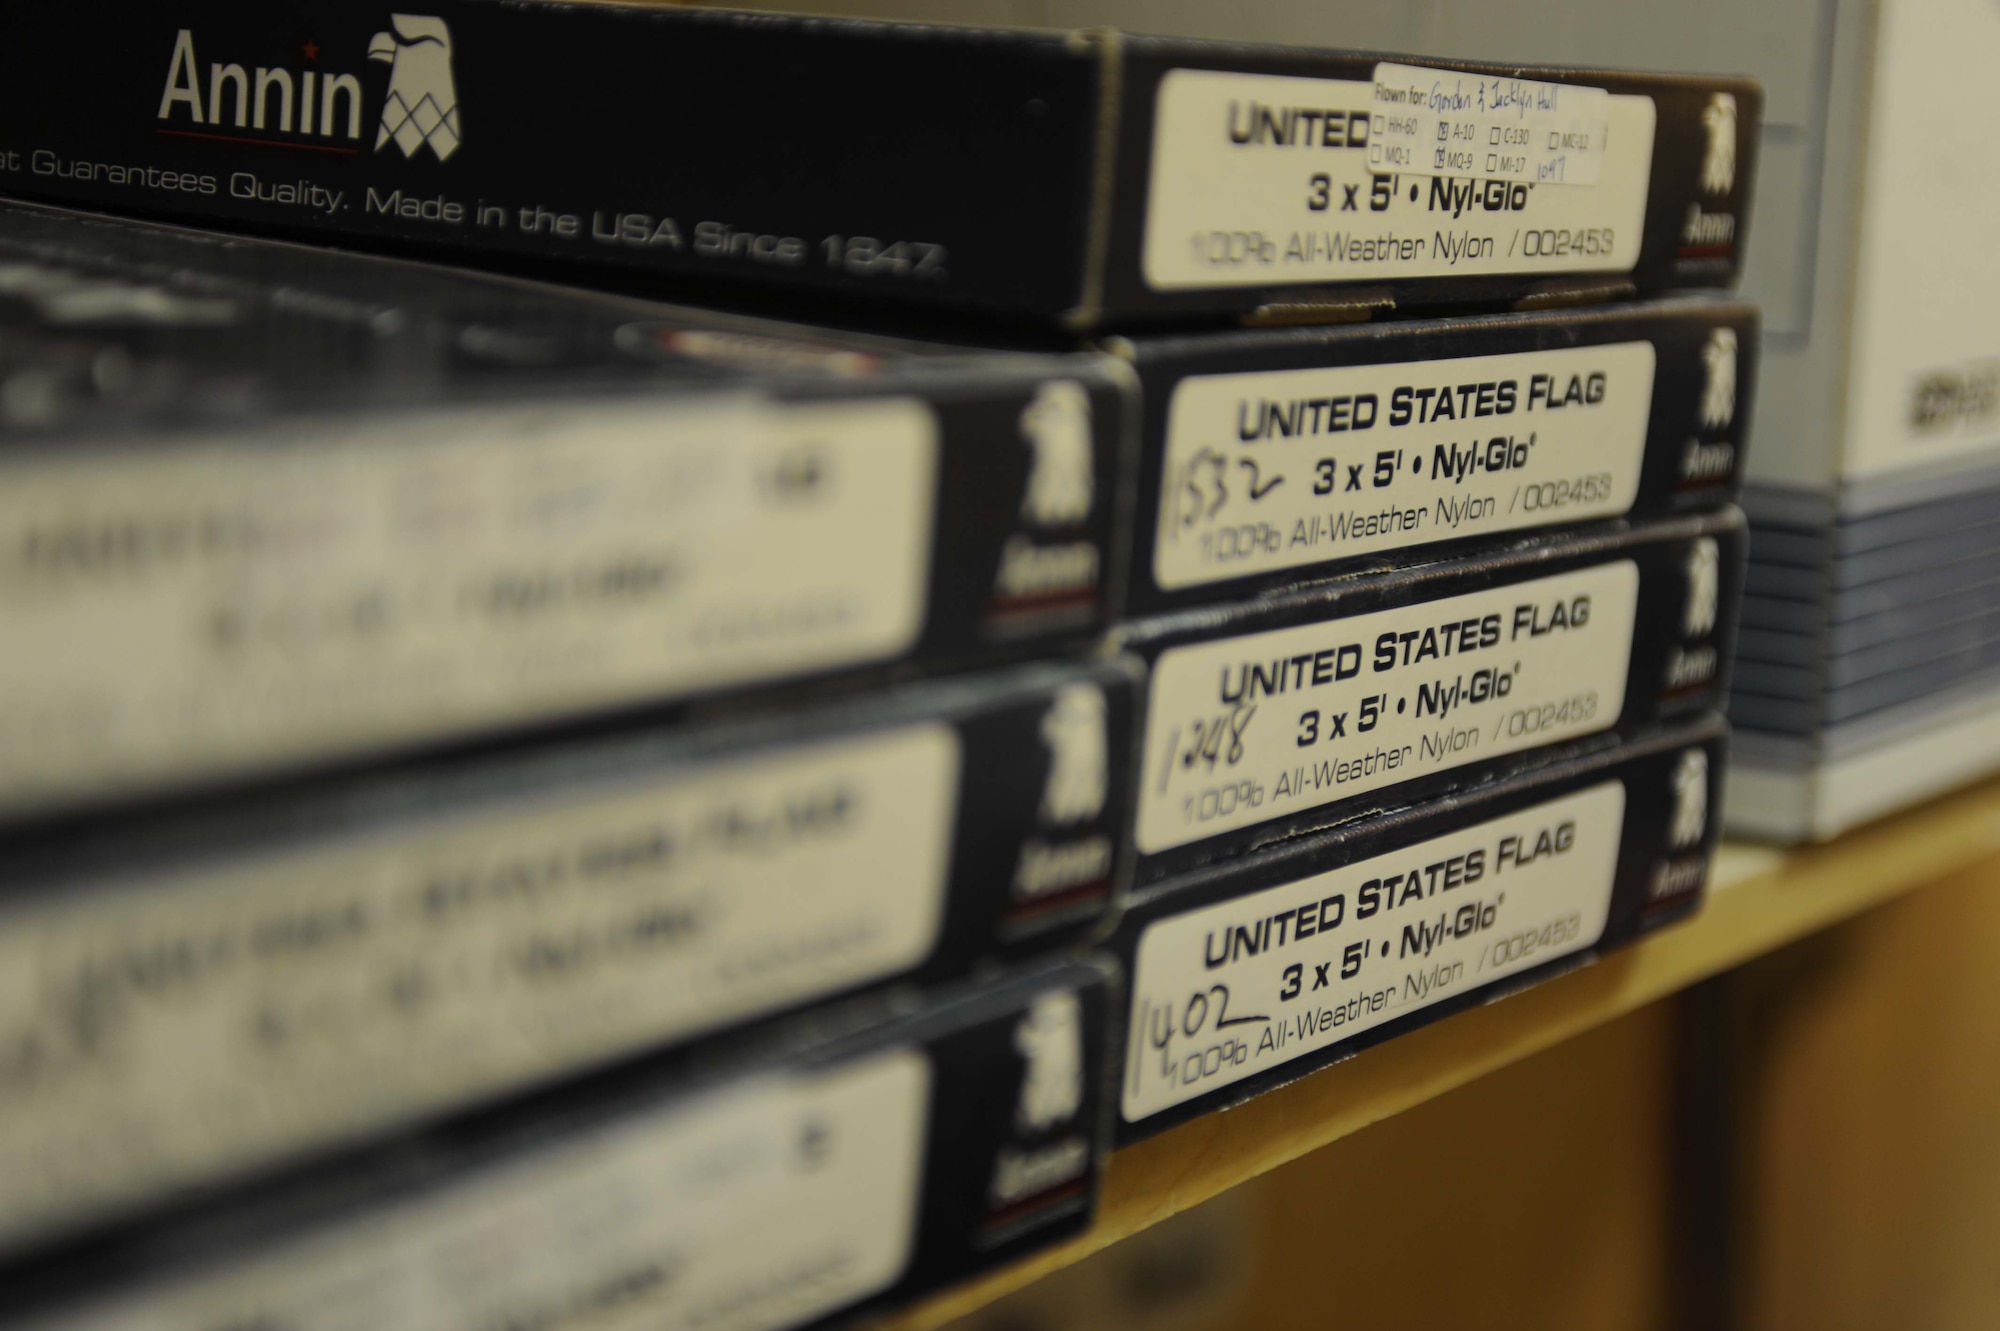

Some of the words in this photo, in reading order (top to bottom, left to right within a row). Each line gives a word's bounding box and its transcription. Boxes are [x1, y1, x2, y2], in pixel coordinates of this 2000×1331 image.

[158, 29, 361, 140] Annin
[1374, 83, 1408, 102] Flown
[1409, 85, 1428, 106] for:
[1428, 79, 1471, 114] Gordon
[1229, 99, 1370, 149] UNITED
[1452, 122, 1476, 142] A-10
[1503, 127, 1530, 146] C-130
[1384, 145, 1411, 166] MQ-1
[1446, 150, 1473, 171] MQ-9
[1499, 154, 1527, 173] MI-17
[31, 149, 217, 195] Guarantees
[229, 172, 349, 215] Quality.
[365, 186, 463, 223] Made
[476, 197, 506, 228] in
[518, 204, 581, 237] the
[591, 209, 684, 251] USA
[693, 219, 806, 268] Since
[1306, 173, 1332, 212] 3
[1340, 184, 1360, 210] x
[1283, 228, 1424, 263] All-Weather
[1432, 228, 1494, 265] Nylon
[1237, 391, 1379, 443] UNITED
[1387, 378, 1518, 428] STATES
[1527, 370, 1607, 411] FLAG
[1312, 458, 1336, 496] 3
[1345, 466, 1363, 492] x
[1289, 503, 1429, 550] All-Weather
[1435, 494, 1495, 532] Nylon
[1219, 641, 1362, 705] UNITED
[1373, 612, 1501, 671] STATES
[1511, 594, 1592, 642] FLAG
[1296, 711, 1319, 748] 3
[1328, 715, 1347, 742] x
[1183, 779, 1265, 826] 100%
[1272, 742, 1412, 802] All-Weather
[1419, 722, 1479, 764] Nylon
[1203, 893, 1346, 971] UNITED
[1356, 855, 1485, 921] STATES
[1496, 820, 1576, 874] FLAG
[1279, 963, 1303, 1002] 3
[1312, 962, 1330, 988] x
[1168, 1038, 1247, 1090] 100%
[1256, 987, 1397, 1056] All-Weather
[1404, 959, 1463, 1006] Nylon
